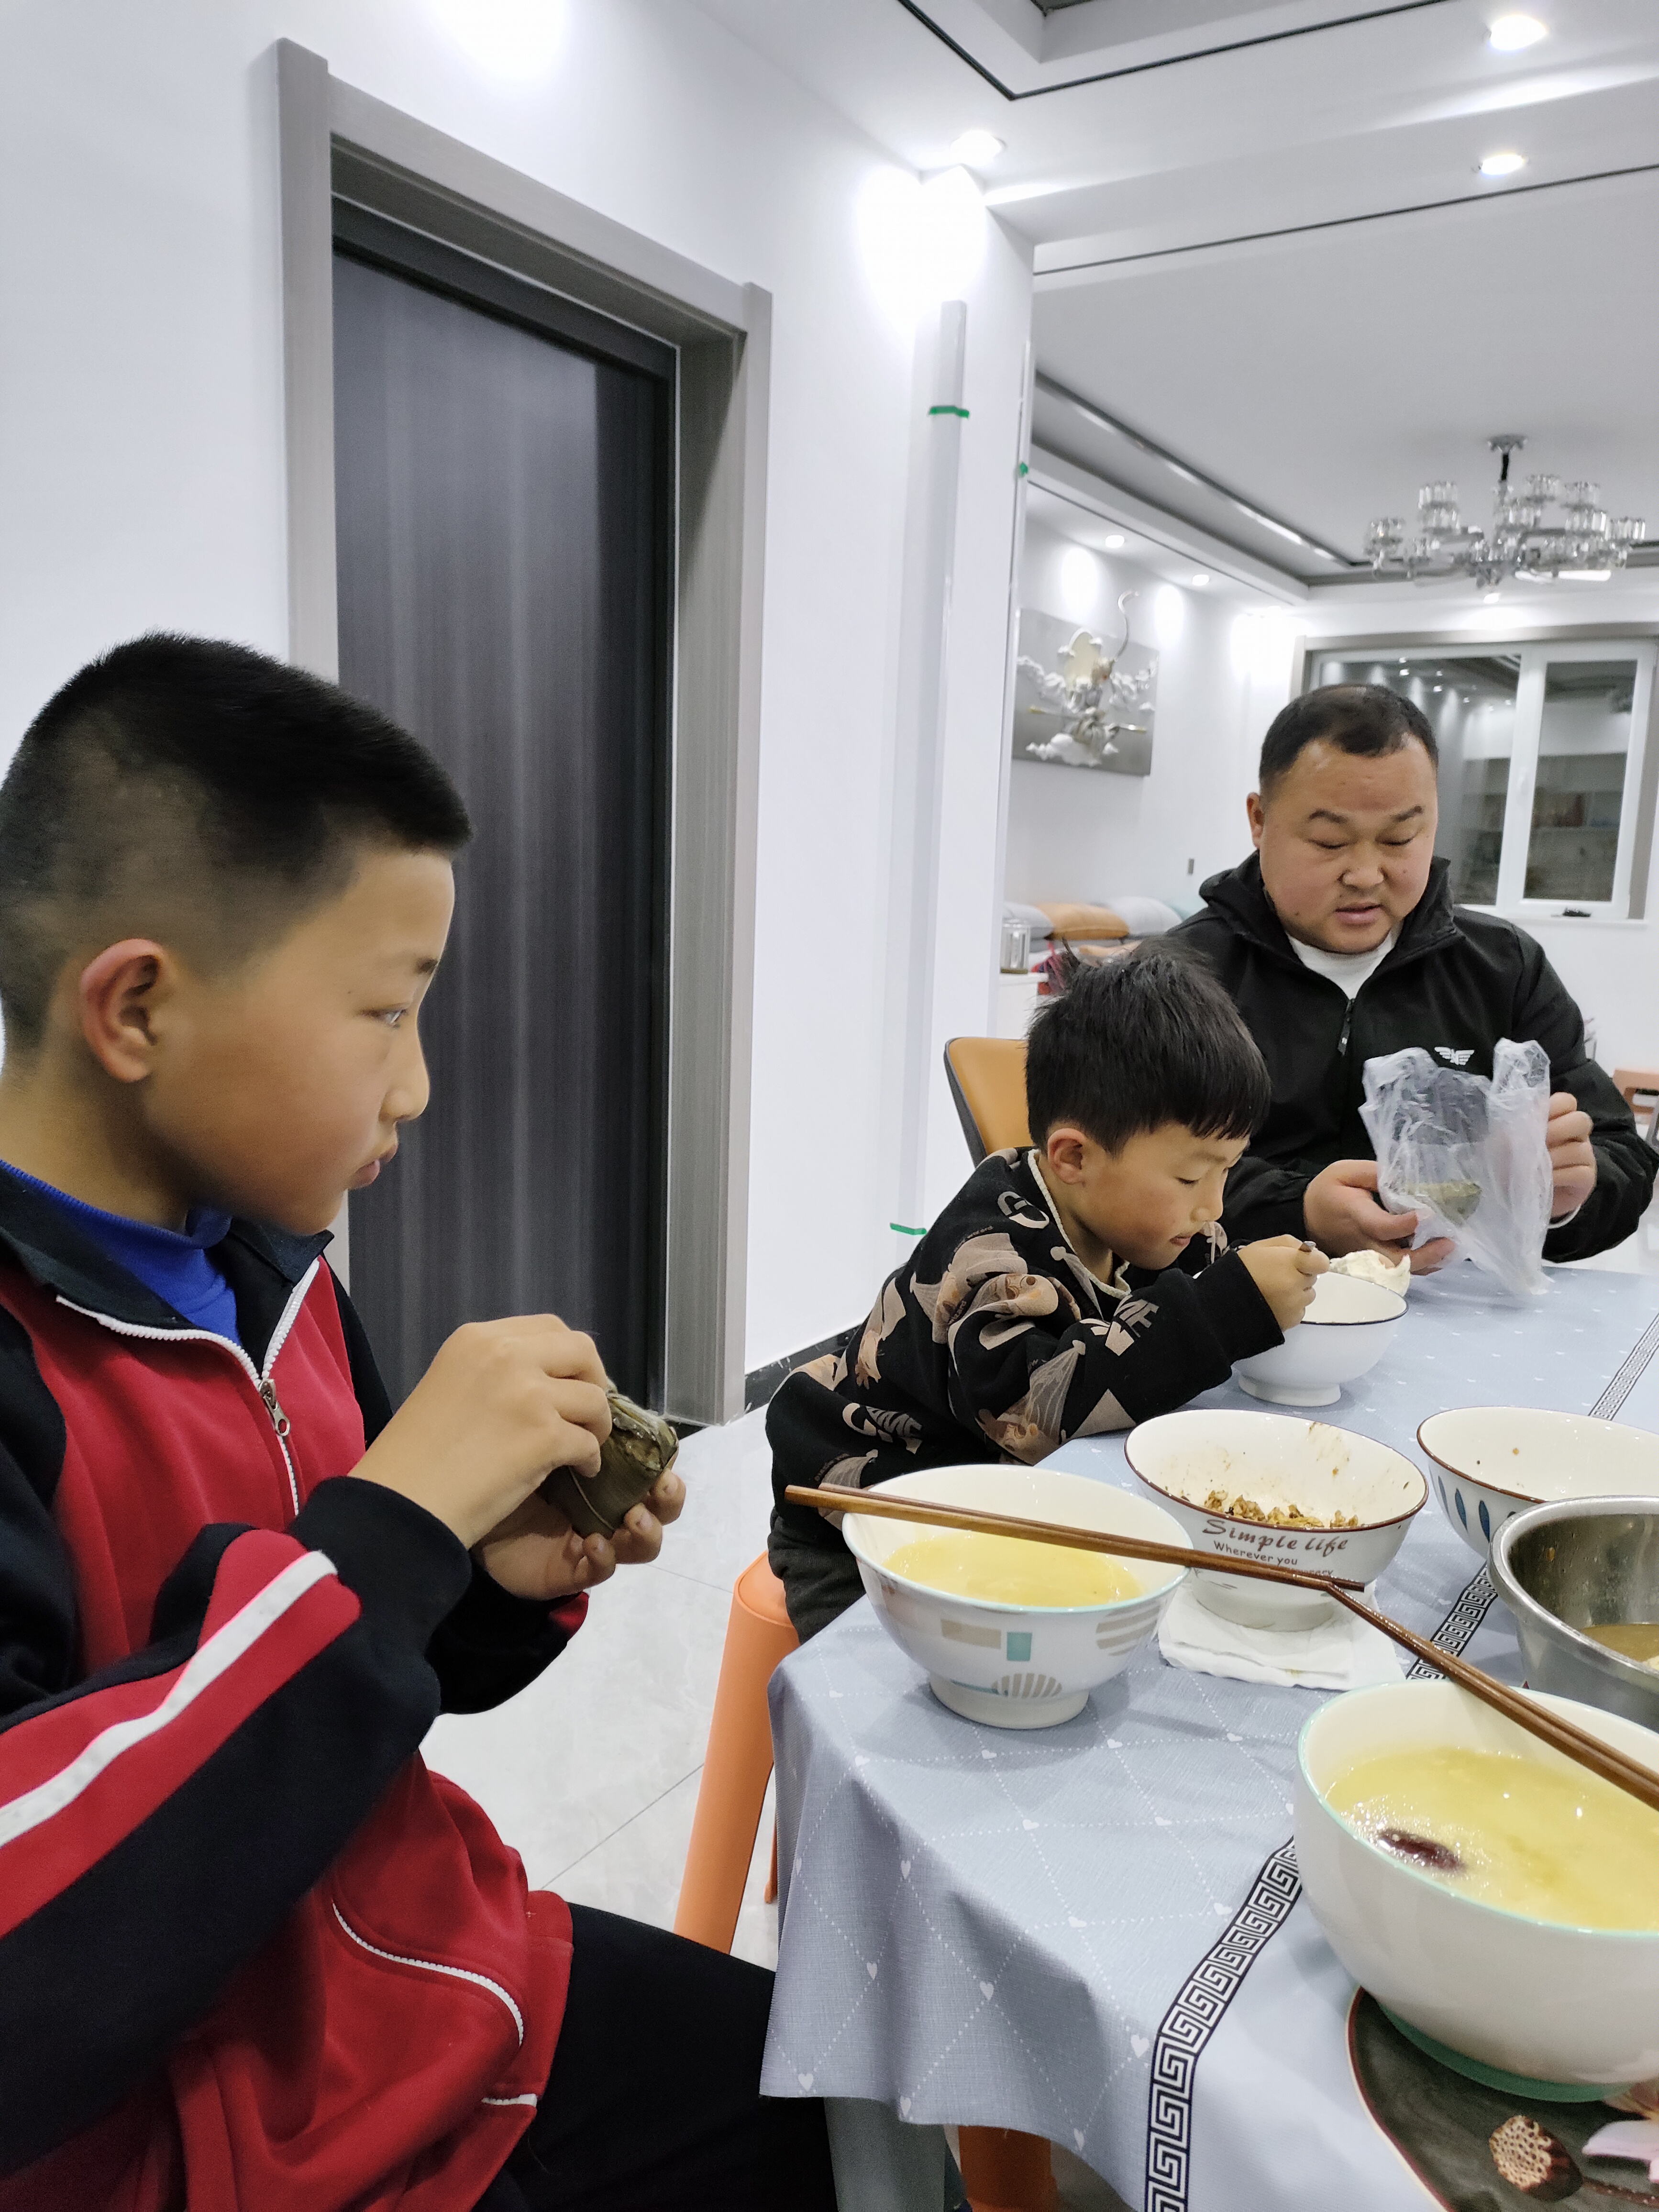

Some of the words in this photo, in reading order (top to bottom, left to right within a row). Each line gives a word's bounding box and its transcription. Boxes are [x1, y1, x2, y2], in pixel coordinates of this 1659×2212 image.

[1202, 1519, 1298, 1551] Simple
[1305, 1536, 1349, 1557] life
[1214, 1540, 1273, 1562] Wherever
[1277, 1557, 1298, 1567] you
